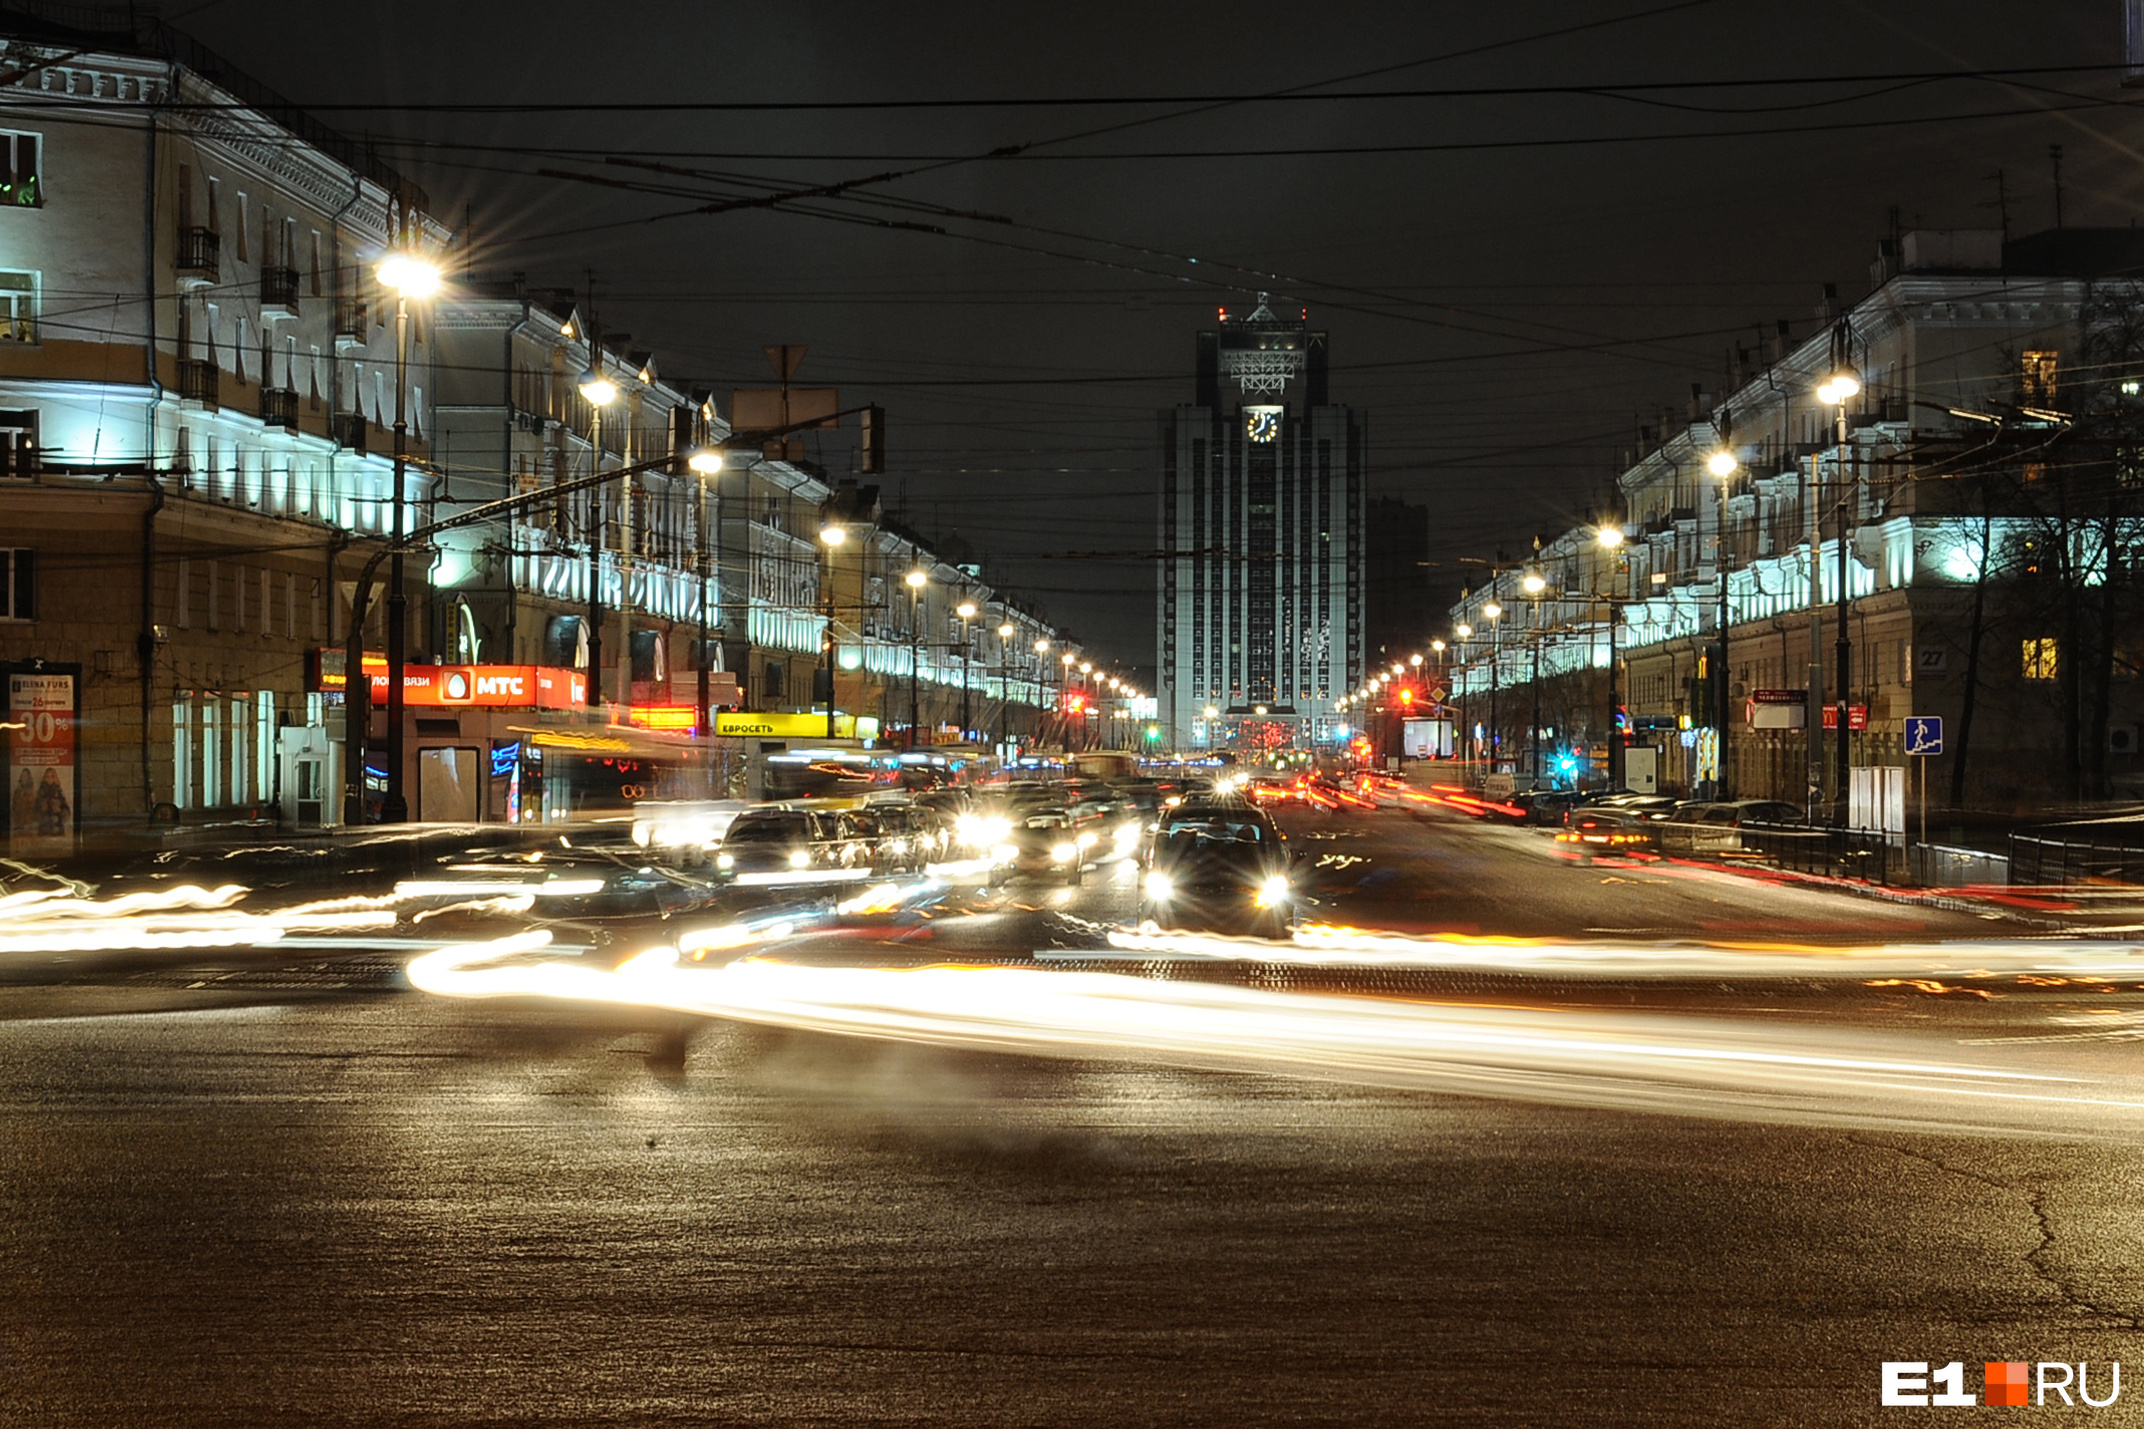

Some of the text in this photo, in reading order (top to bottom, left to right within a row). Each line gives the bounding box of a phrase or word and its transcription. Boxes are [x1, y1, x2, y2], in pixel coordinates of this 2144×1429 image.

[1922, 651, 1943, 665] 27
[22, 681, 69, 689] ELENA FURS
[477, 677, 523, 695] МТС
[32, 697, 44, 707] 26
[20, 711, 68, 742] 30%
[722, 725, 774, 733] ЕВРОСЕТЬ
